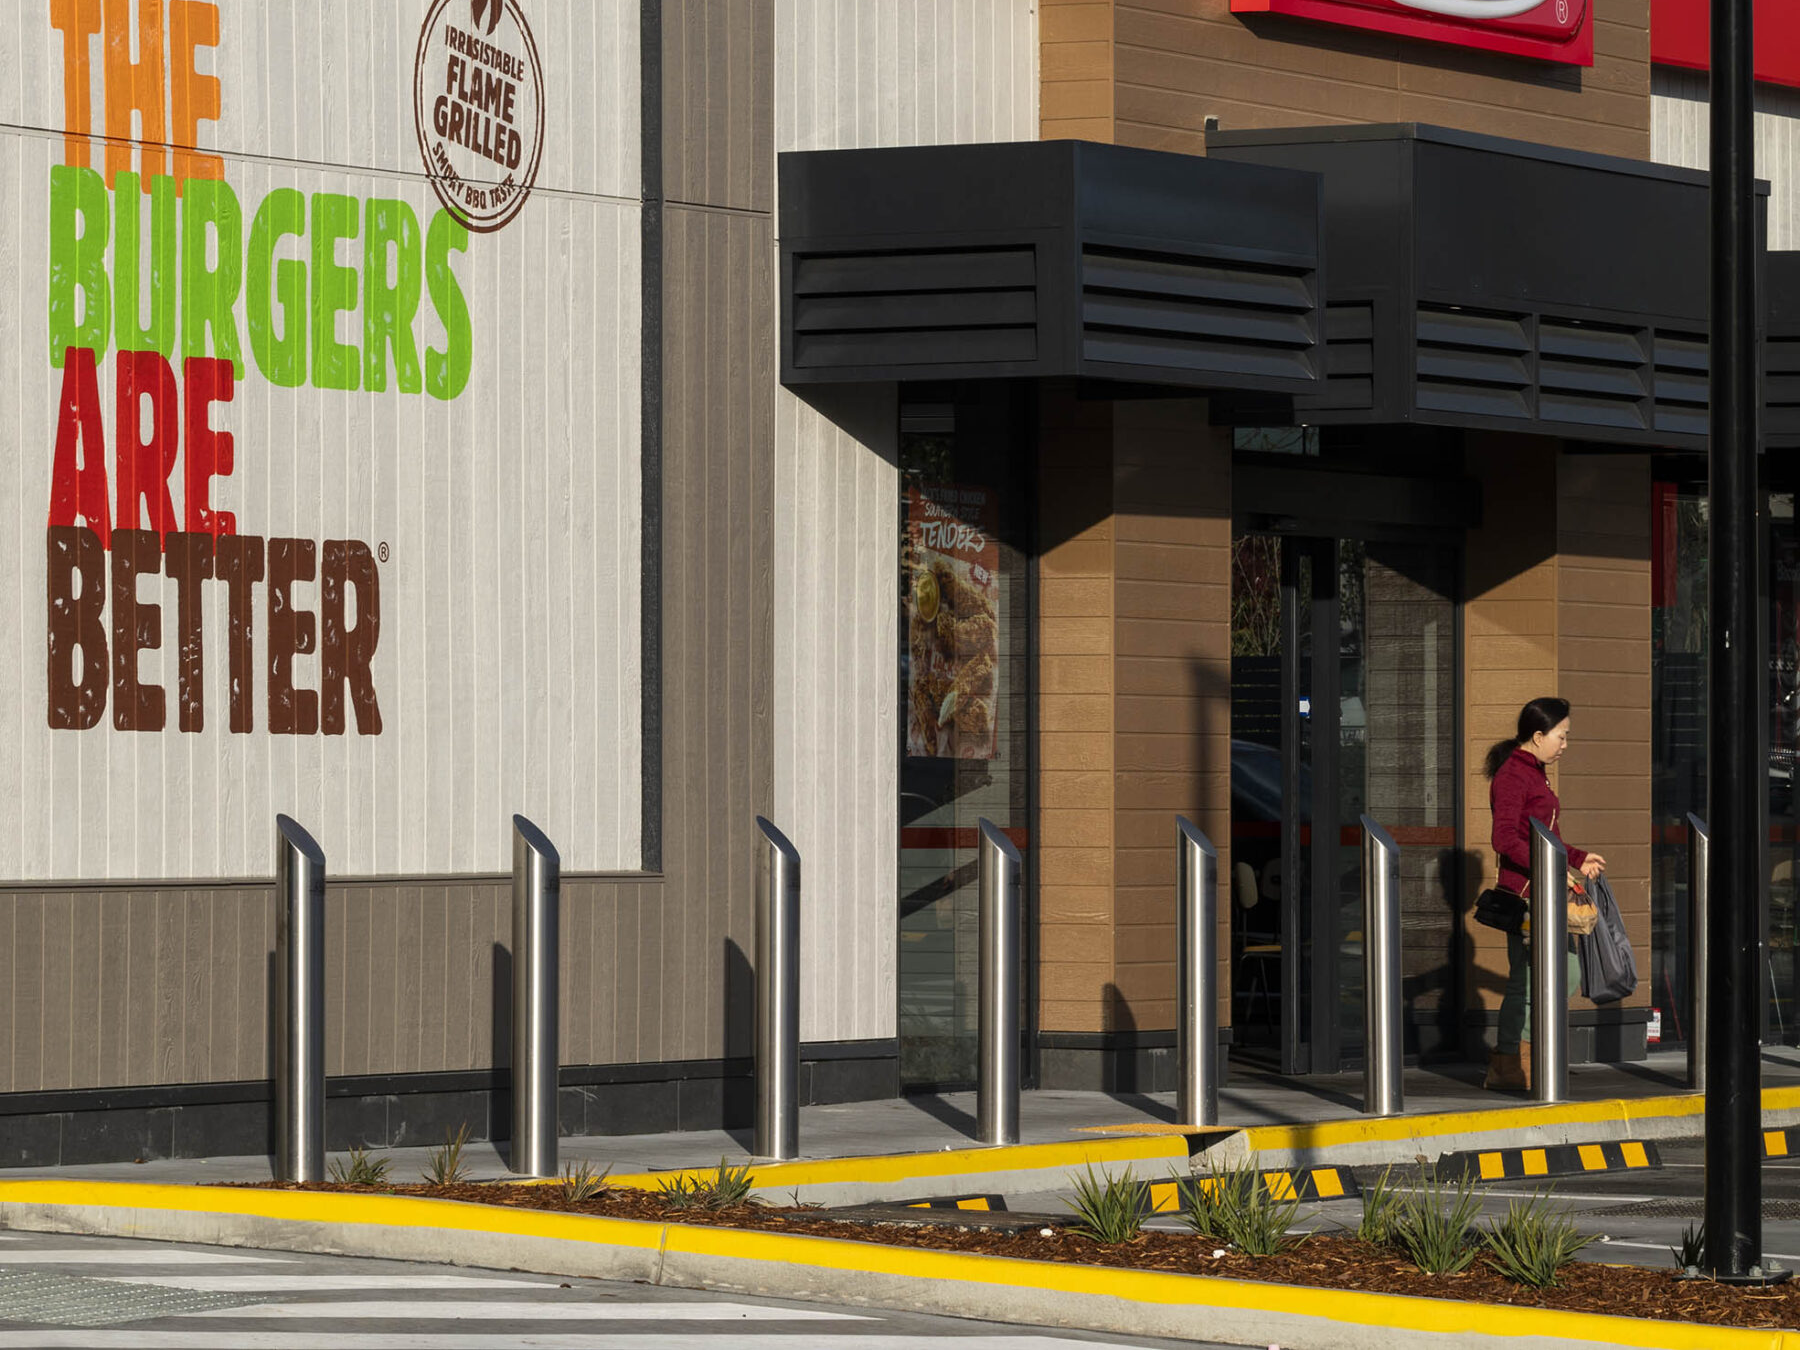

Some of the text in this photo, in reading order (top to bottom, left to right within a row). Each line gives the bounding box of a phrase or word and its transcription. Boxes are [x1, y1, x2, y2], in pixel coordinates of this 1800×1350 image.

[446, 53, 517, 125] FLAME
[433, 94, 523, 171] GRILLED
[464, 184, 488, 210] BBQ
[489, 171, 516, 209] TASTE
[47, 164, 473, 401] BURGERS
[48, 346, 237, 555] ARE
[919, 521, 986, 553] TENDERS
